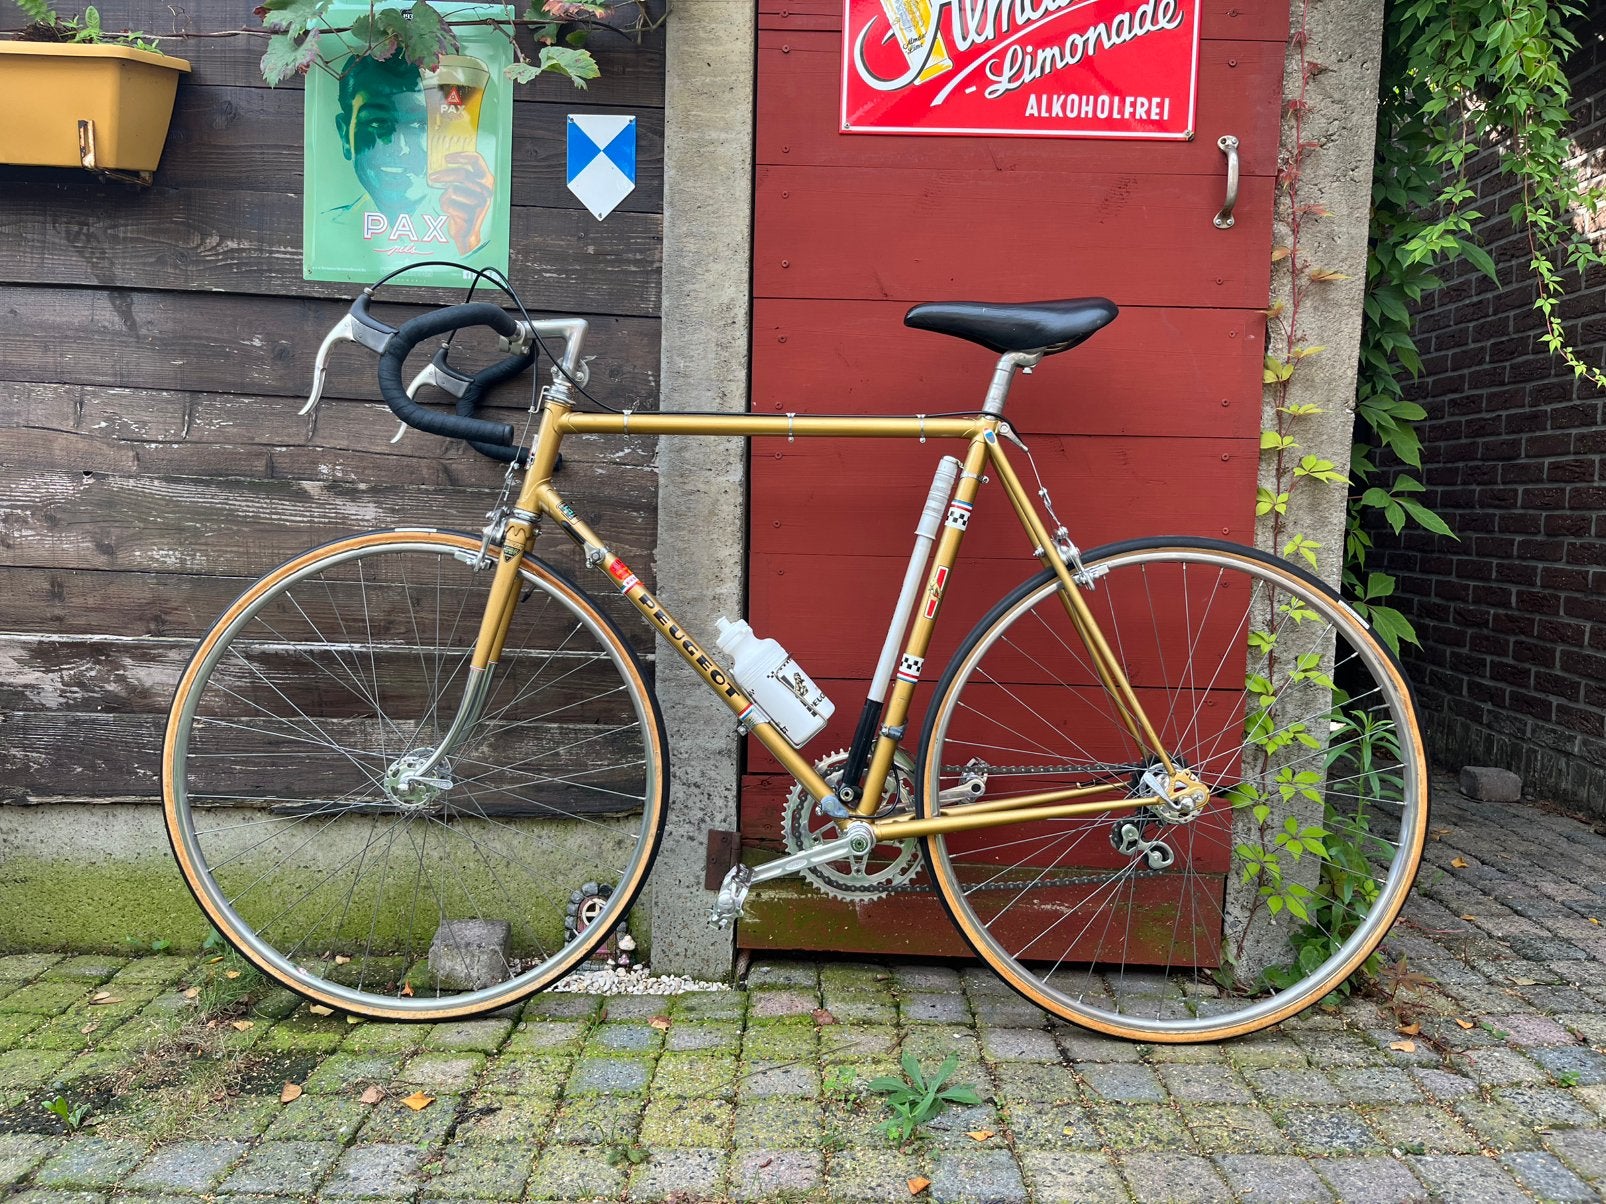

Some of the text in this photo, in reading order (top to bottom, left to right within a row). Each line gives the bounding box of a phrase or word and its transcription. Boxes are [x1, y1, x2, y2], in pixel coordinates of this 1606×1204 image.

[440, 105, 466, 114] PAX
[1025, 94, 1170, 120] ALKOHOLFREI
[363, 211, 449, 244] PAX
[639, 593, 740, 698] PEUGEOT
